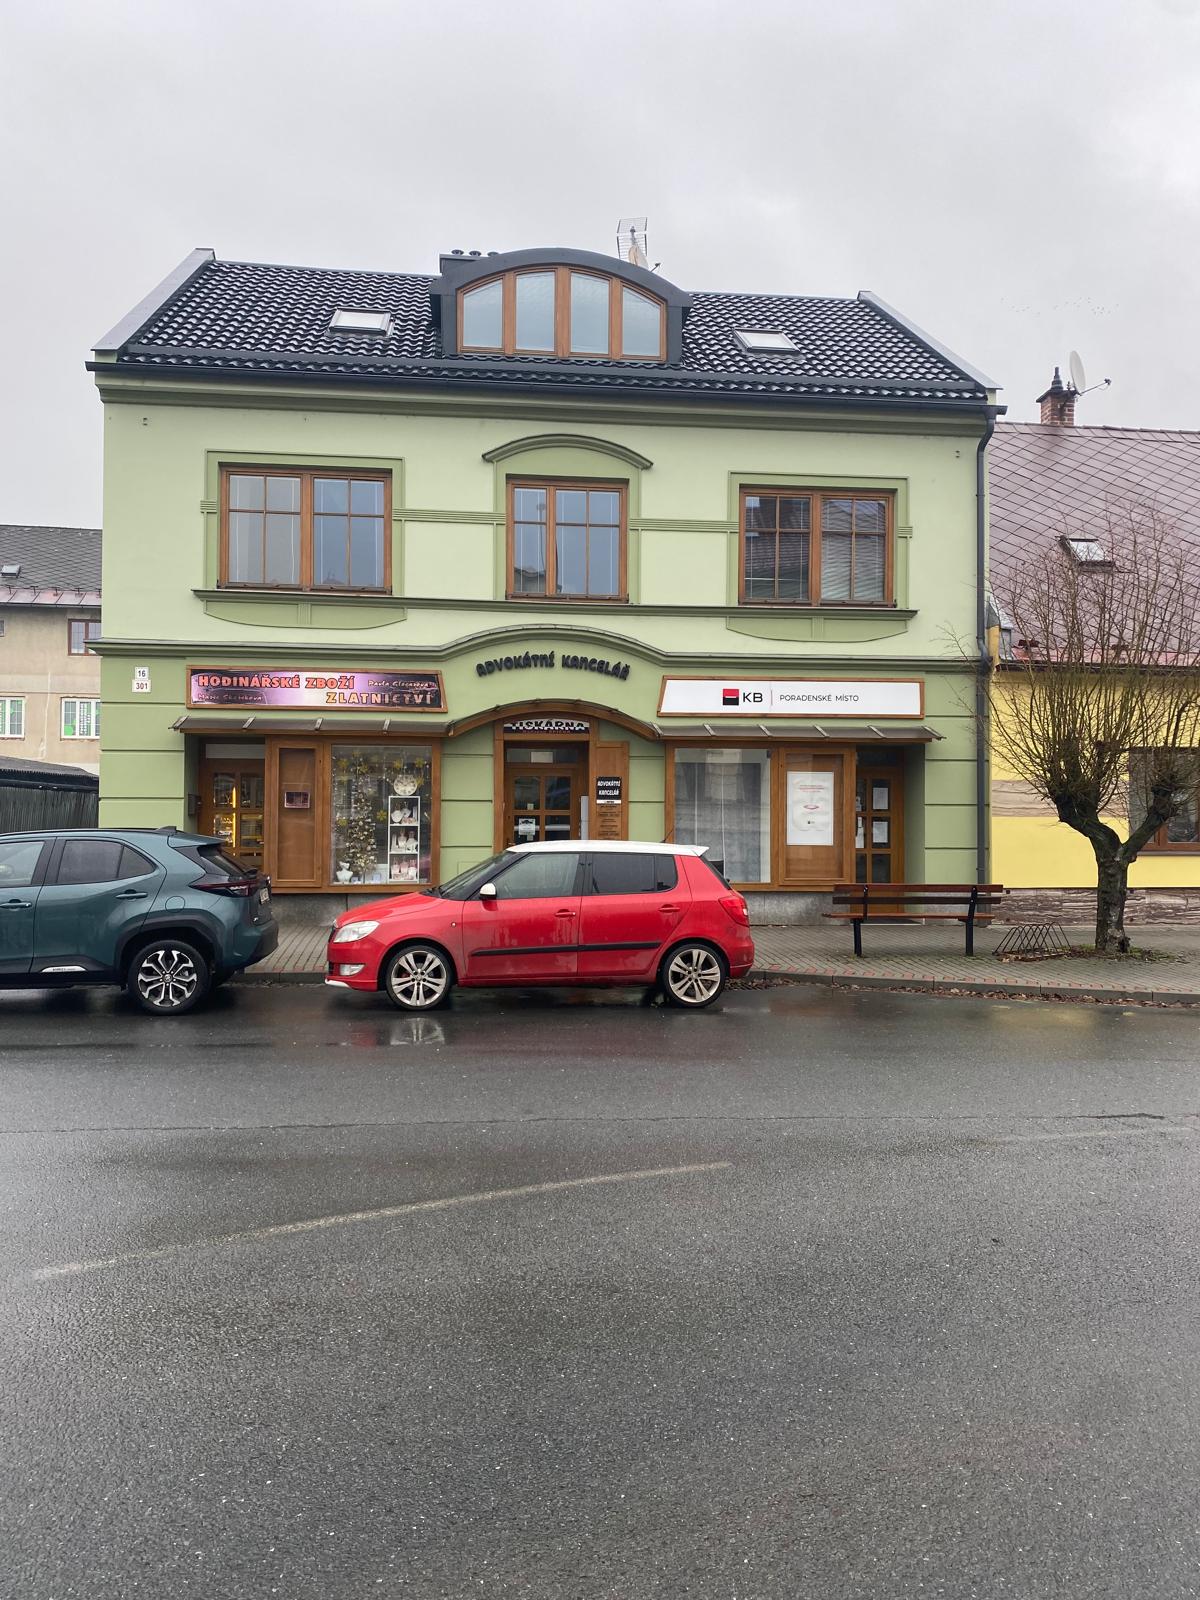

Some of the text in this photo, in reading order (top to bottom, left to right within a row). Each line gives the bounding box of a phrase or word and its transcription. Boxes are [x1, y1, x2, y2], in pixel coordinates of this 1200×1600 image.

[476, 651, 631, 681] ADVOKÁTNÍ KANCELÁŘ
[138, 669, 146, 678] 16
[135, 682, 149, 690] 301
[198, 674, 355, 690] HODINÁŘSKÉ ZBOŽÍ
[326, 691, 432, 705] ZLATNICTVÍ
[742, 692, 763, 703] KB
[779, 693, 860, 702] PORADENSKÉ MÍSTO
